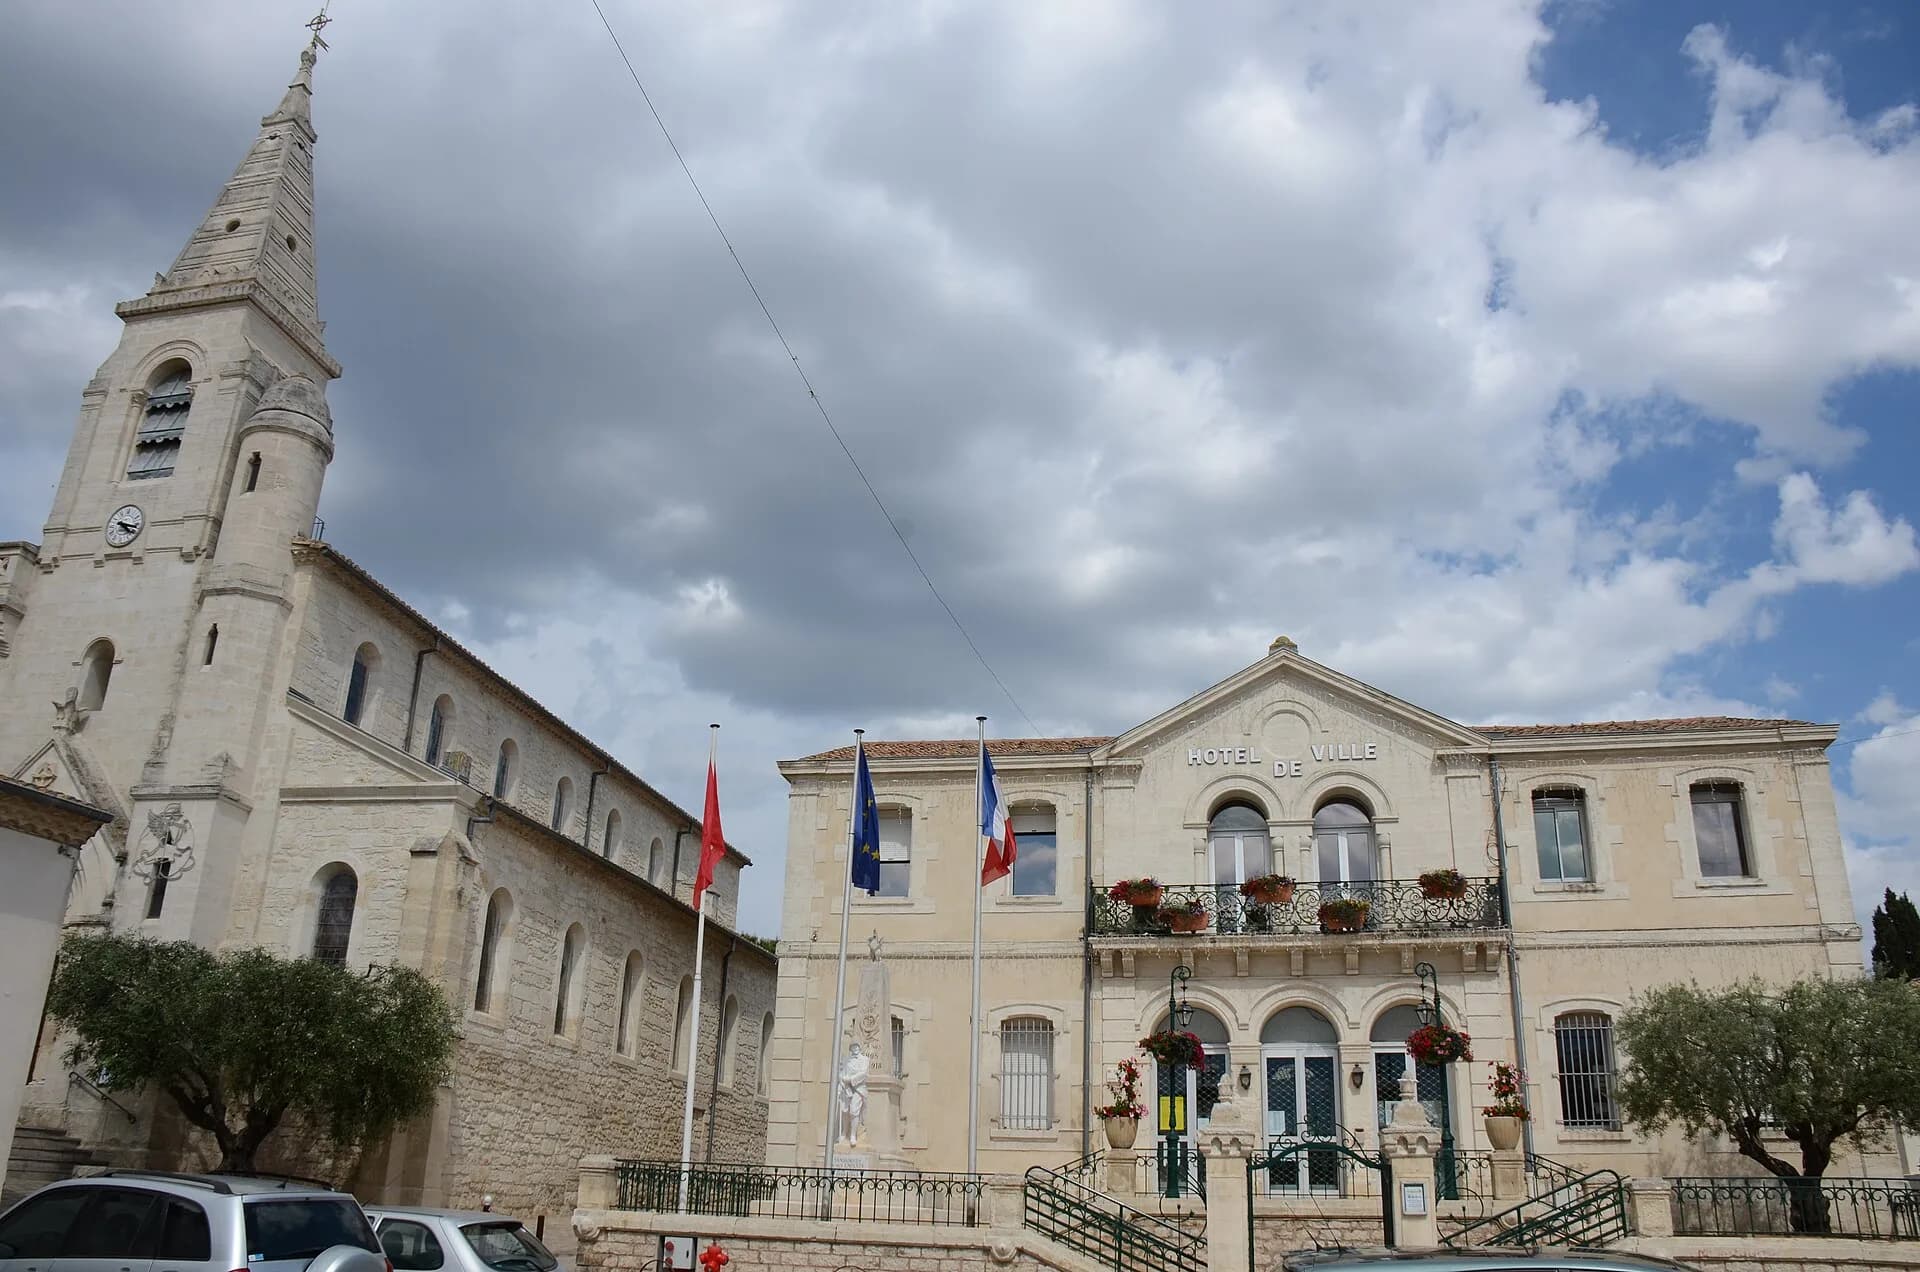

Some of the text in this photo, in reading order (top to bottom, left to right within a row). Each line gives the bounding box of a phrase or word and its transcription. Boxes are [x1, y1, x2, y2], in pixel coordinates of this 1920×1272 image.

[1187, 742, 1377, 777] HOTEL DE VILLE
